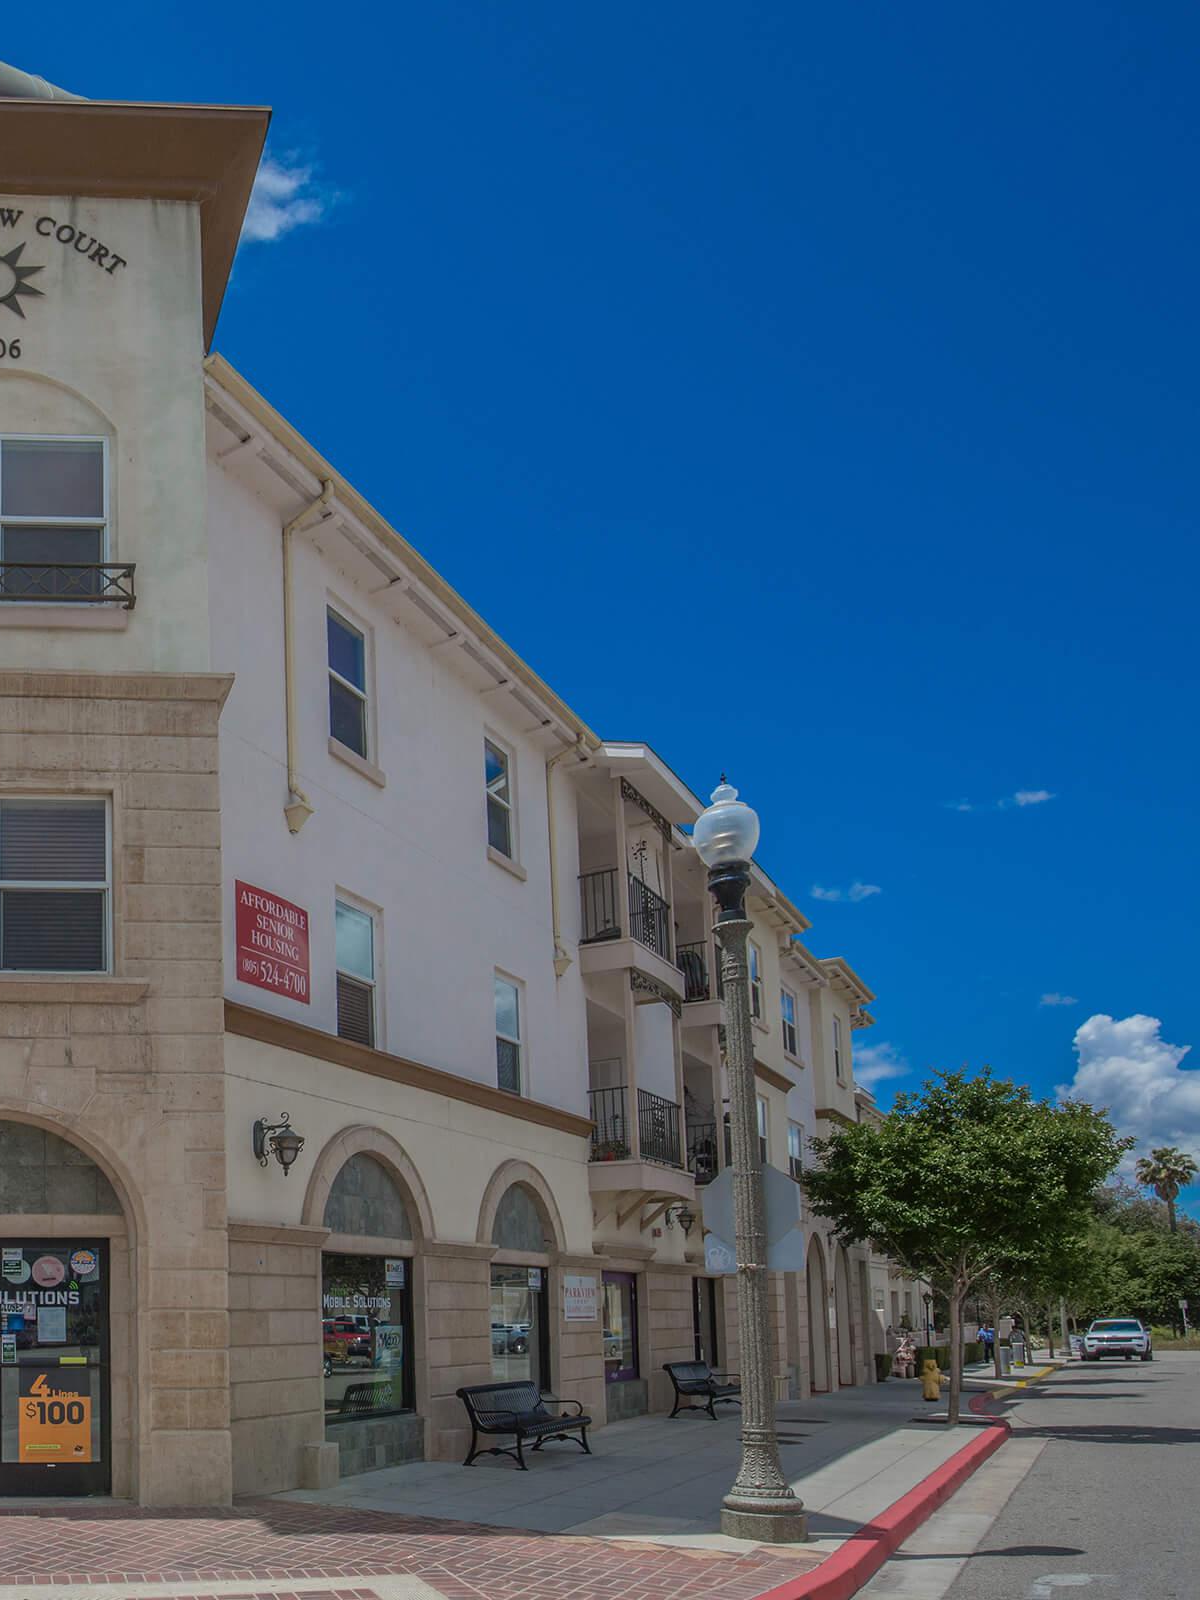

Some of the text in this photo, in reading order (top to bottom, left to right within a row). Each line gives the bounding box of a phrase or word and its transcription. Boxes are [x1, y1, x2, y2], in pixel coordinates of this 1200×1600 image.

[35, 216, 127, 275] COURT
[240, 890, 306, 930] AFFORDABLE
[256, 914, 294, 942] SENIOR
[251, 929, 299, 961] HOUSING
[260, 960, 306, 996] 524-4700
[323, 1294, 392, 1310] MOBILE SOLUTIONS
[30, 1374, 50, 1398] 4
[25, 1401, 85, 1425] $100
